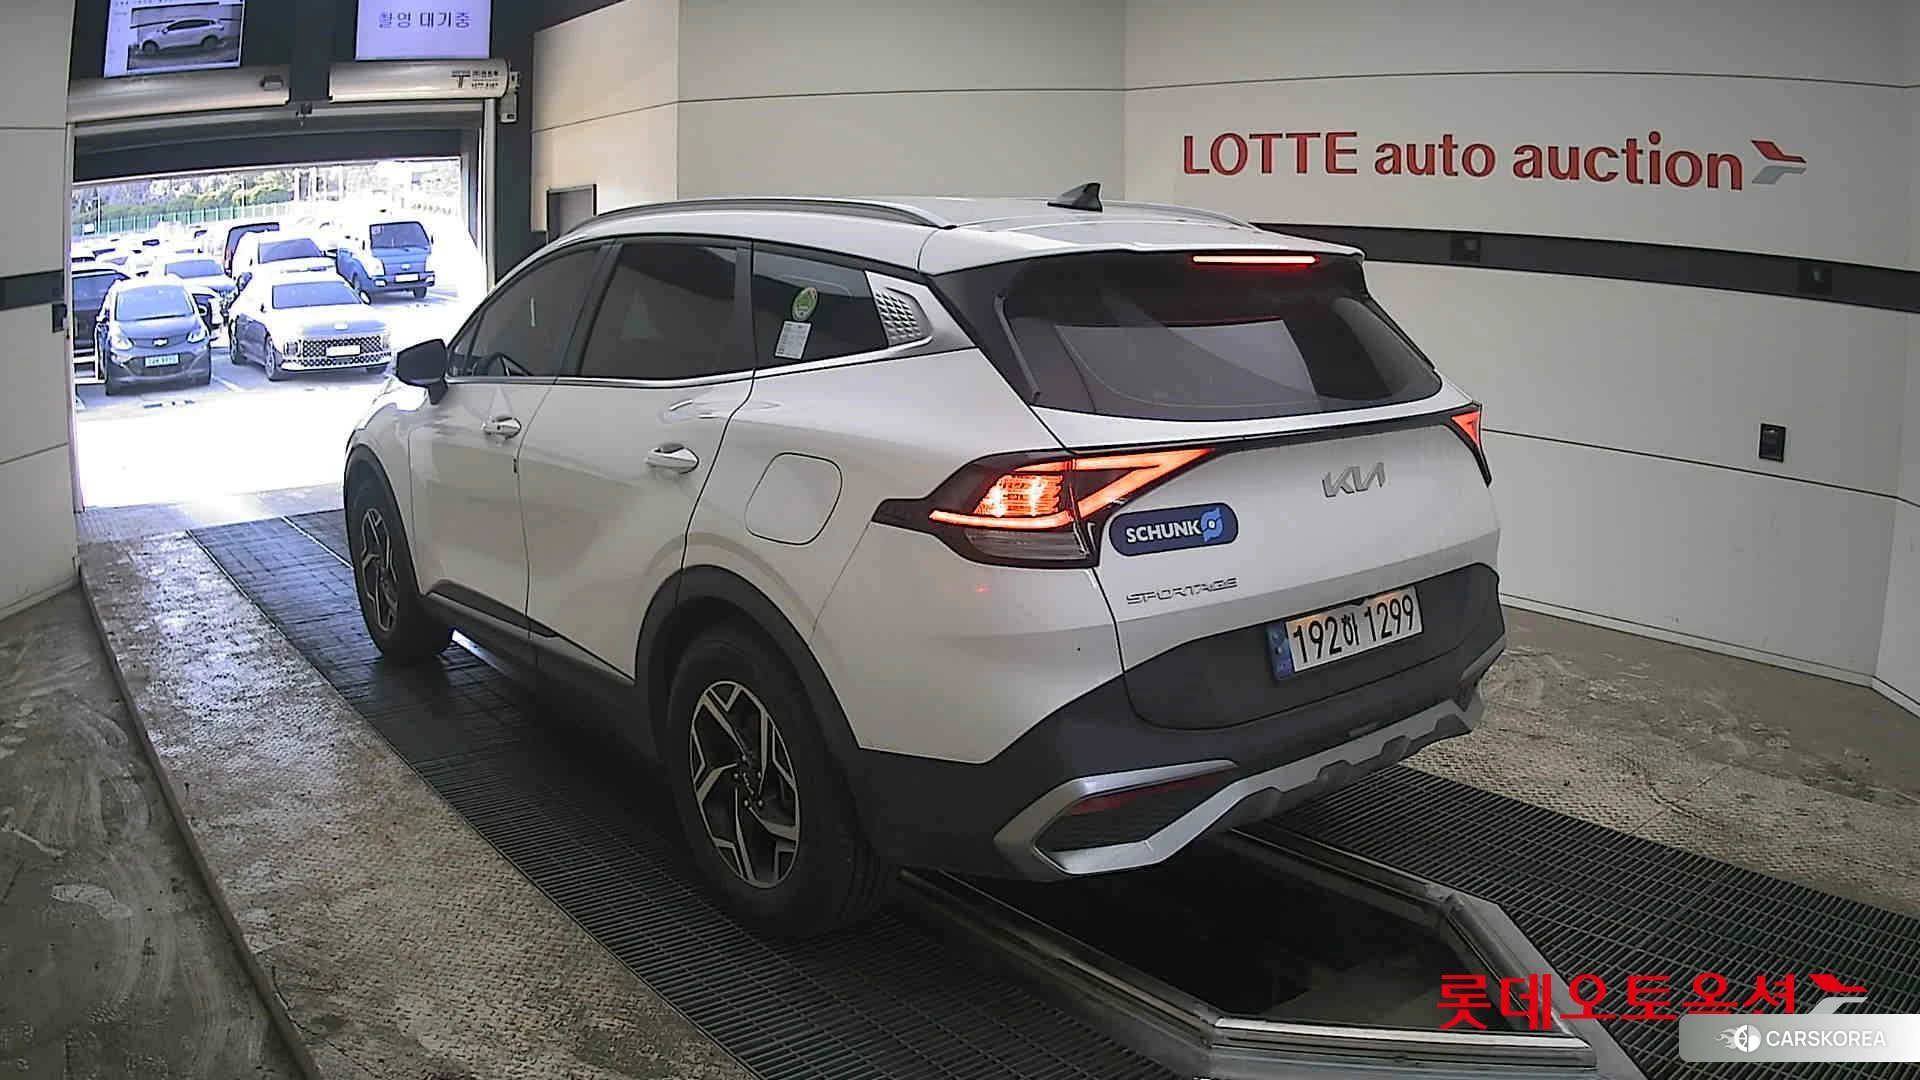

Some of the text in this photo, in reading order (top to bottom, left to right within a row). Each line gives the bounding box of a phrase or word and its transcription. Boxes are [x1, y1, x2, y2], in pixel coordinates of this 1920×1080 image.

[419, 11, 472, 29] 대기중
[1183, 131, 1744, 191] LOTTE auto auction
[1126, 520, 1203, 544] SCHUNK
[1125, 576, 1239, 605] SPORTAGE
[1293, 594, 1414, 663] 192하 1299
